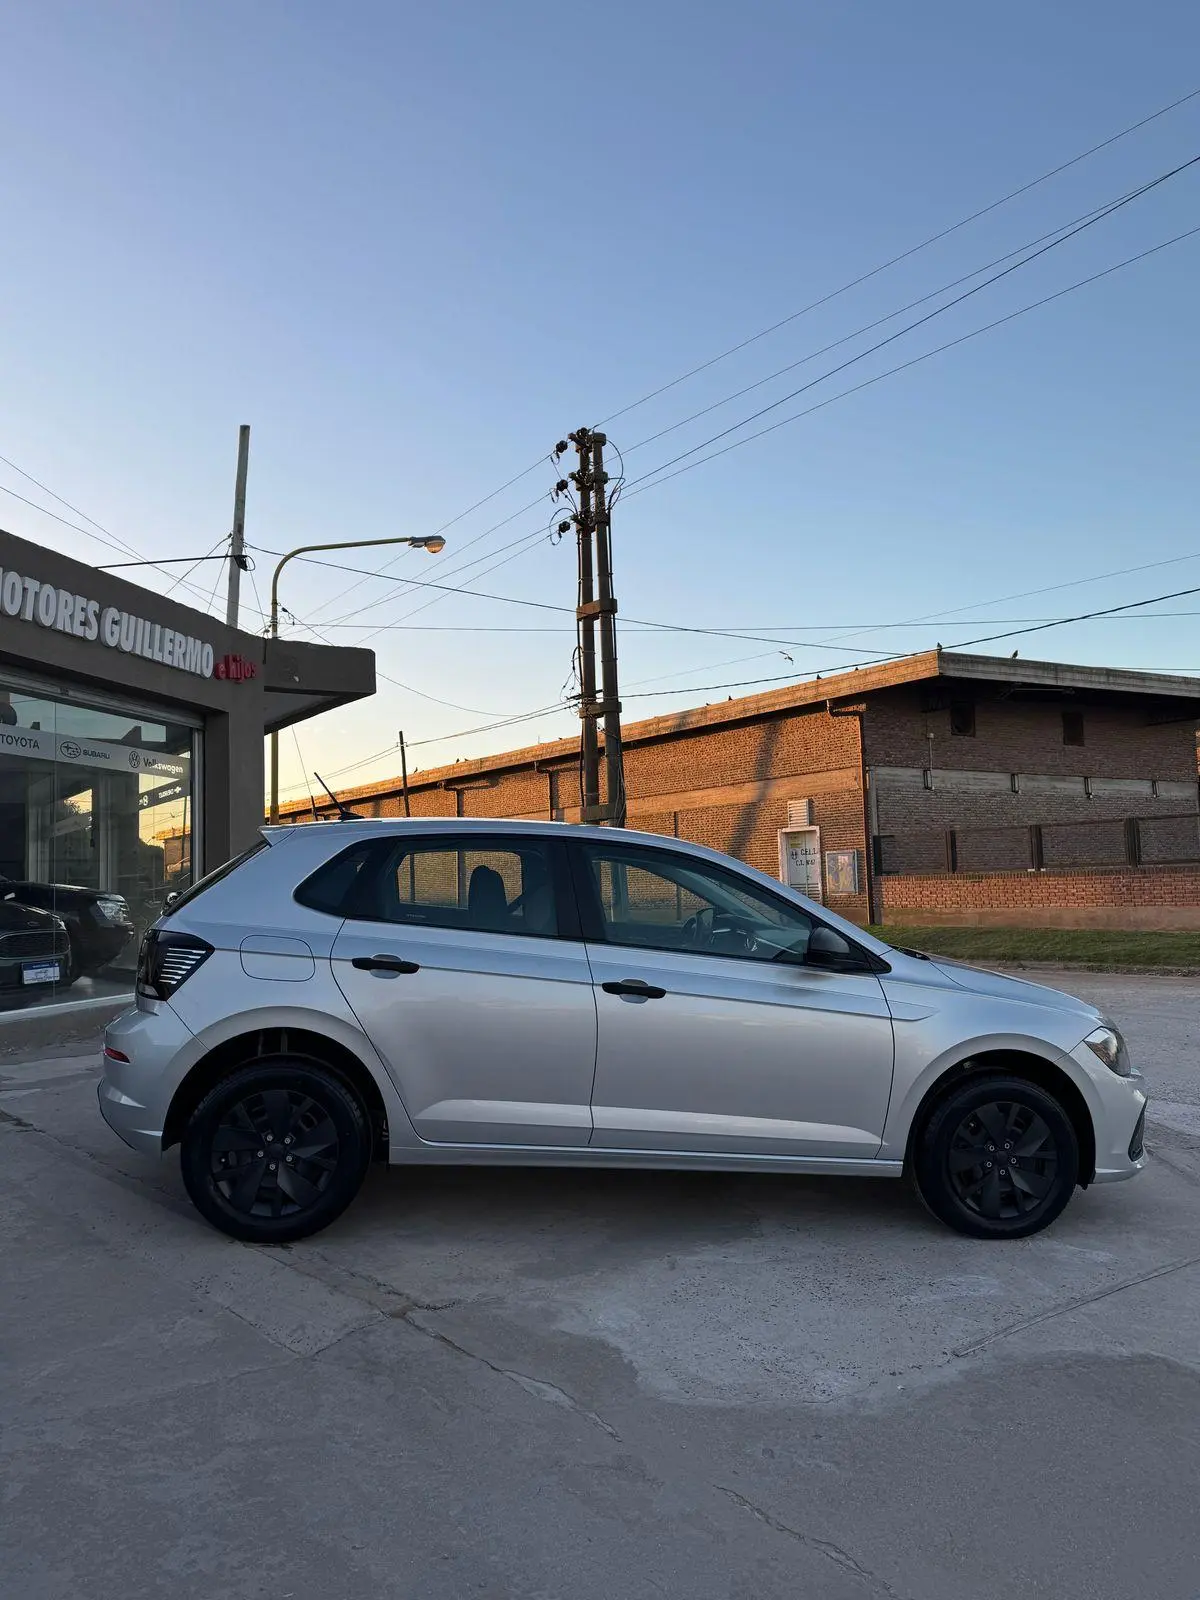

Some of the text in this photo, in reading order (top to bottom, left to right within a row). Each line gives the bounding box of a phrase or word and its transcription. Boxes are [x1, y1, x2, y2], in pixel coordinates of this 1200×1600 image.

[0, 566, 257, 683] OTORES GUILLERMO e hijos
[0, 733, 40, 750] TOYOTA
[82, 749, 110, 759] SUBARU
[143, 757, 183, 774] Volkswagen
